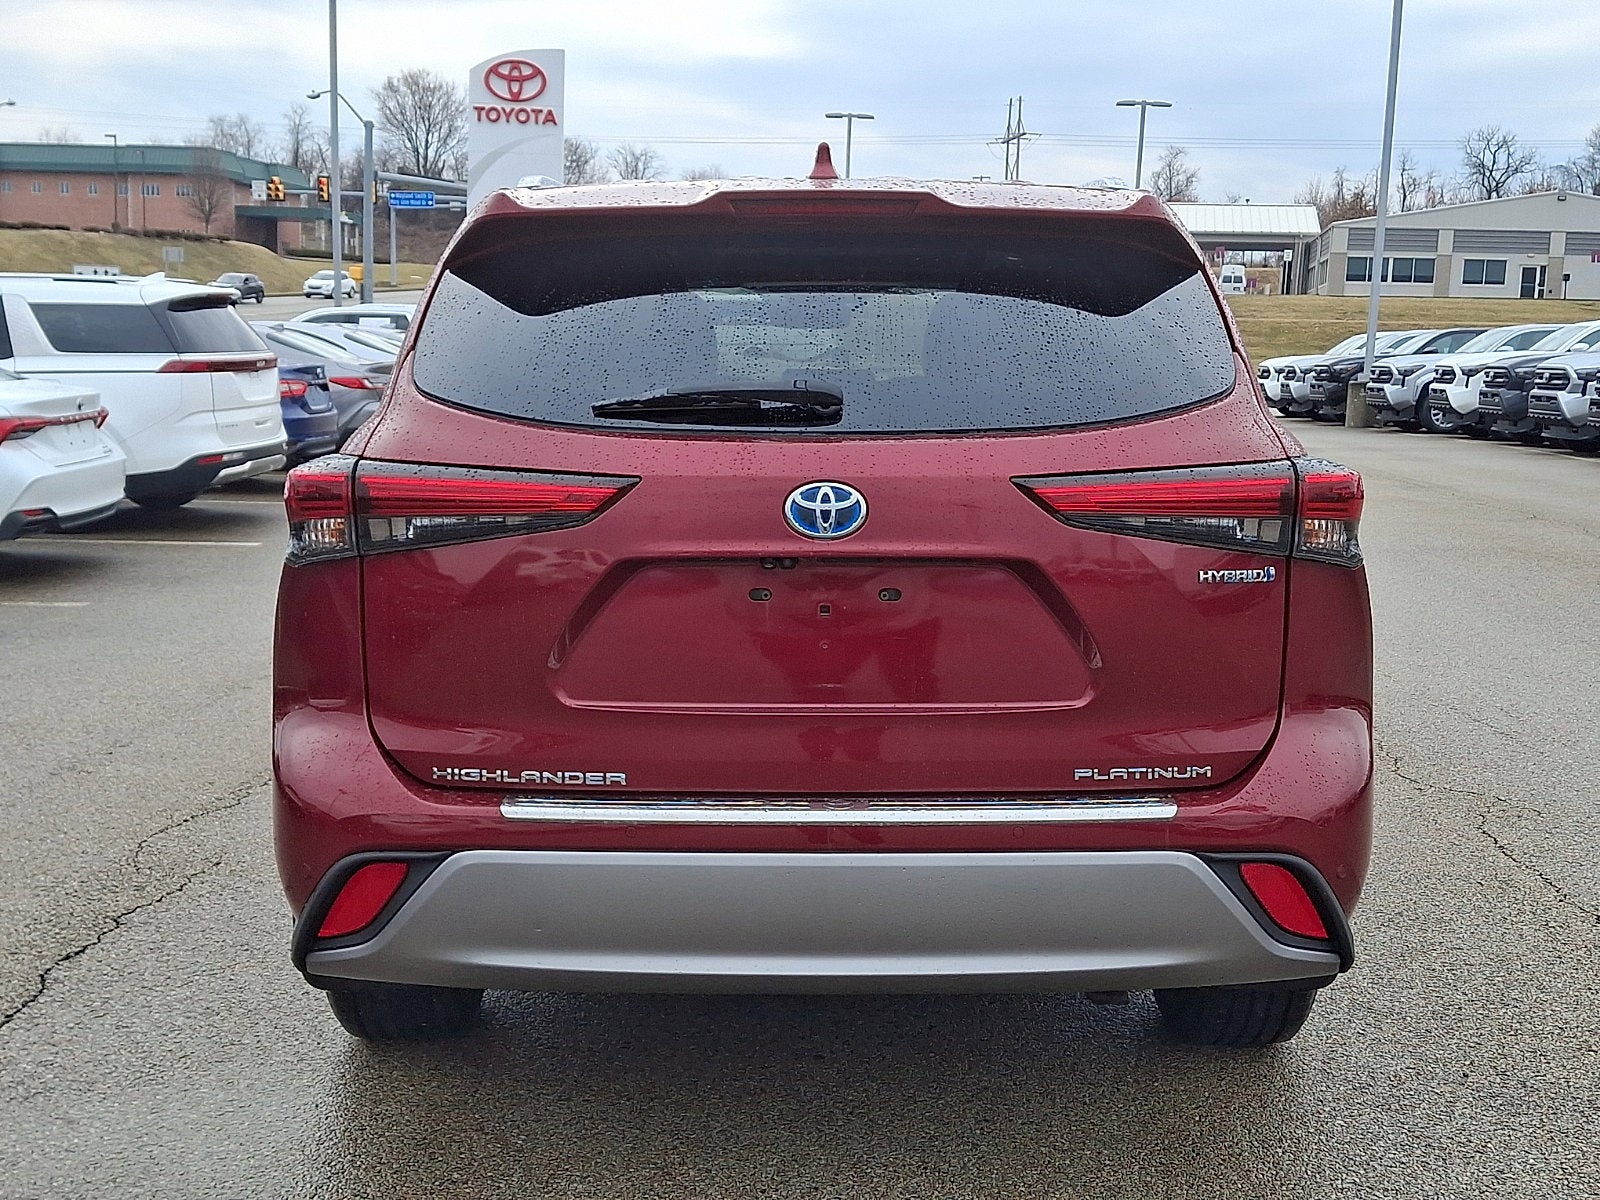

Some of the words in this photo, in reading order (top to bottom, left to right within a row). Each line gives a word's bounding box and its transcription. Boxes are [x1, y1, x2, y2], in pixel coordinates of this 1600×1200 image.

[473, 106, 557, 126] TOYOTA
[1199, 569, 1265, 583] HYBRID
[432, 767, 627, 785] HIGHLANDER
[1074, 766, 1212, 781] PLATINUM
